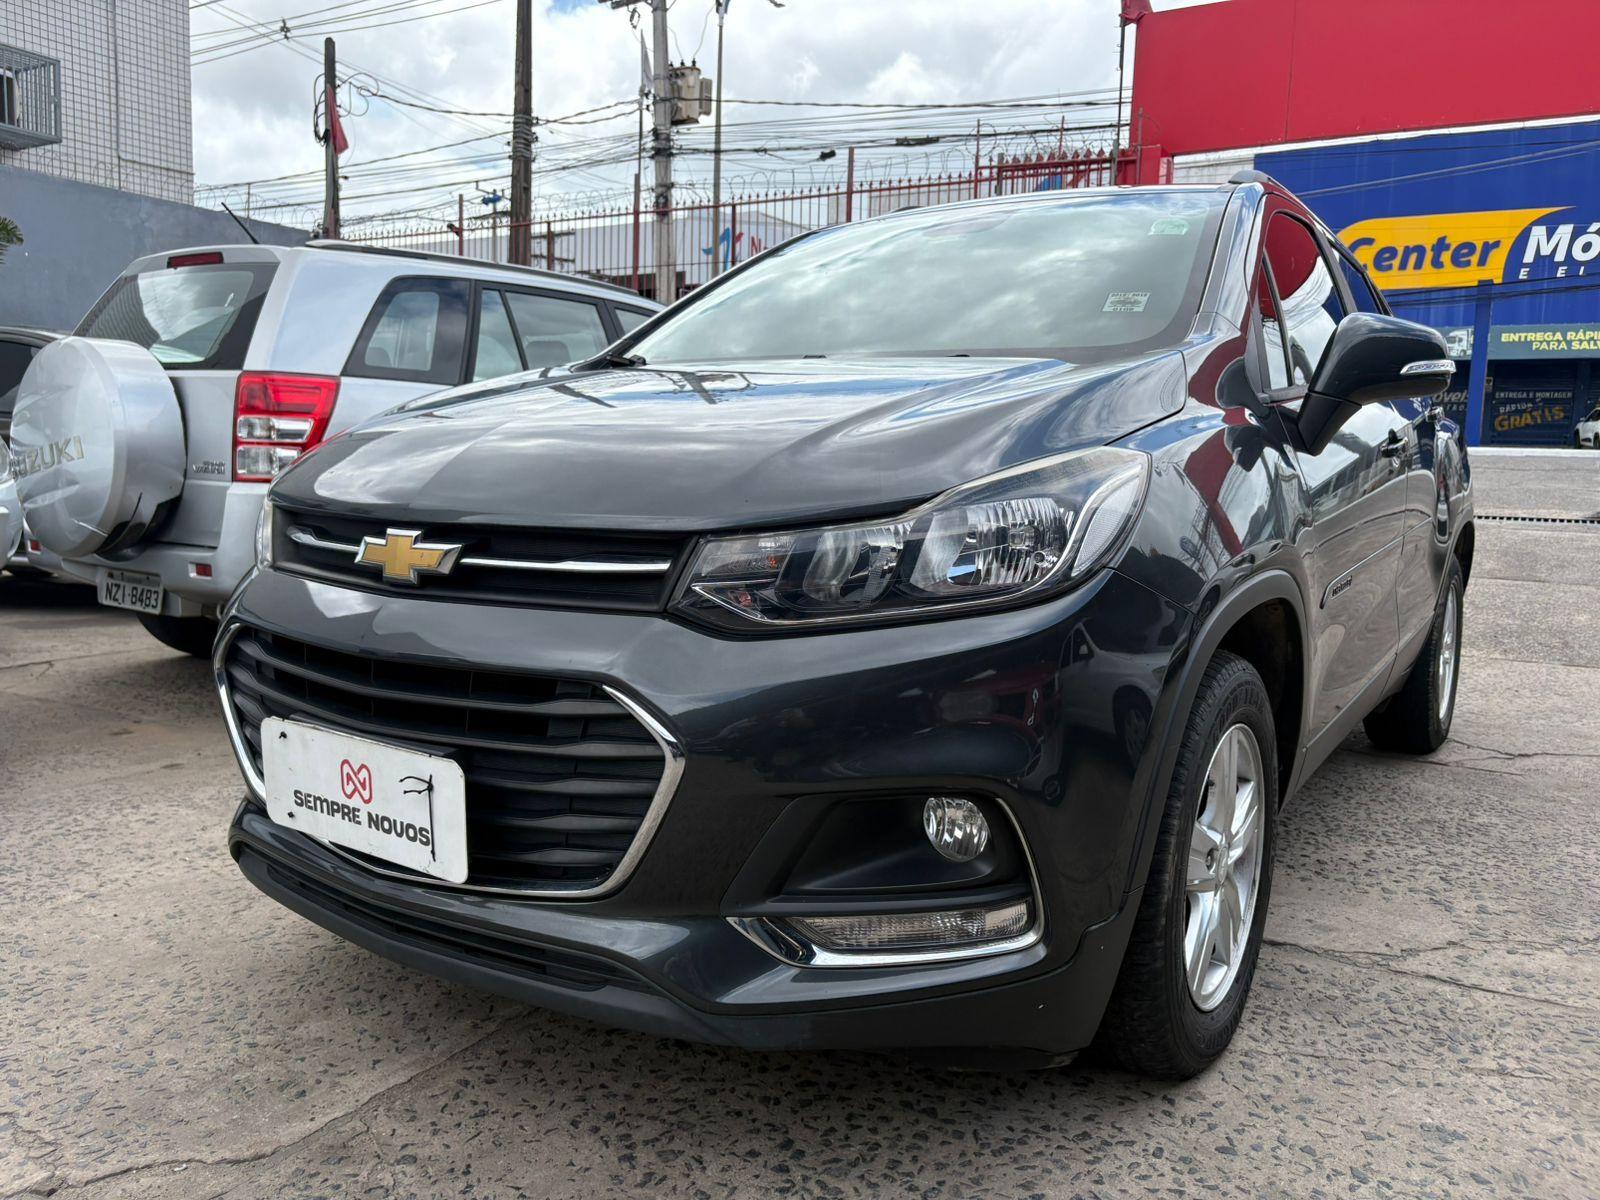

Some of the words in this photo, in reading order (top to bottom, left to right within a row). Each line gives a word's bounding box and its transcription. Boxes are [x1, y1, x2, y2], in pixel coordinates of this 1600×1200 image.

[1348, 236, 1501, 272] Center
[1522, 222, 1600, 263] Mó
[1519, 267, 1530, 279] E
[1501, 331, 1563, 342] ENTREGA
[1532, 341, 1567, 351] PARA
[293, 789, 362, 826] SEMPRE
